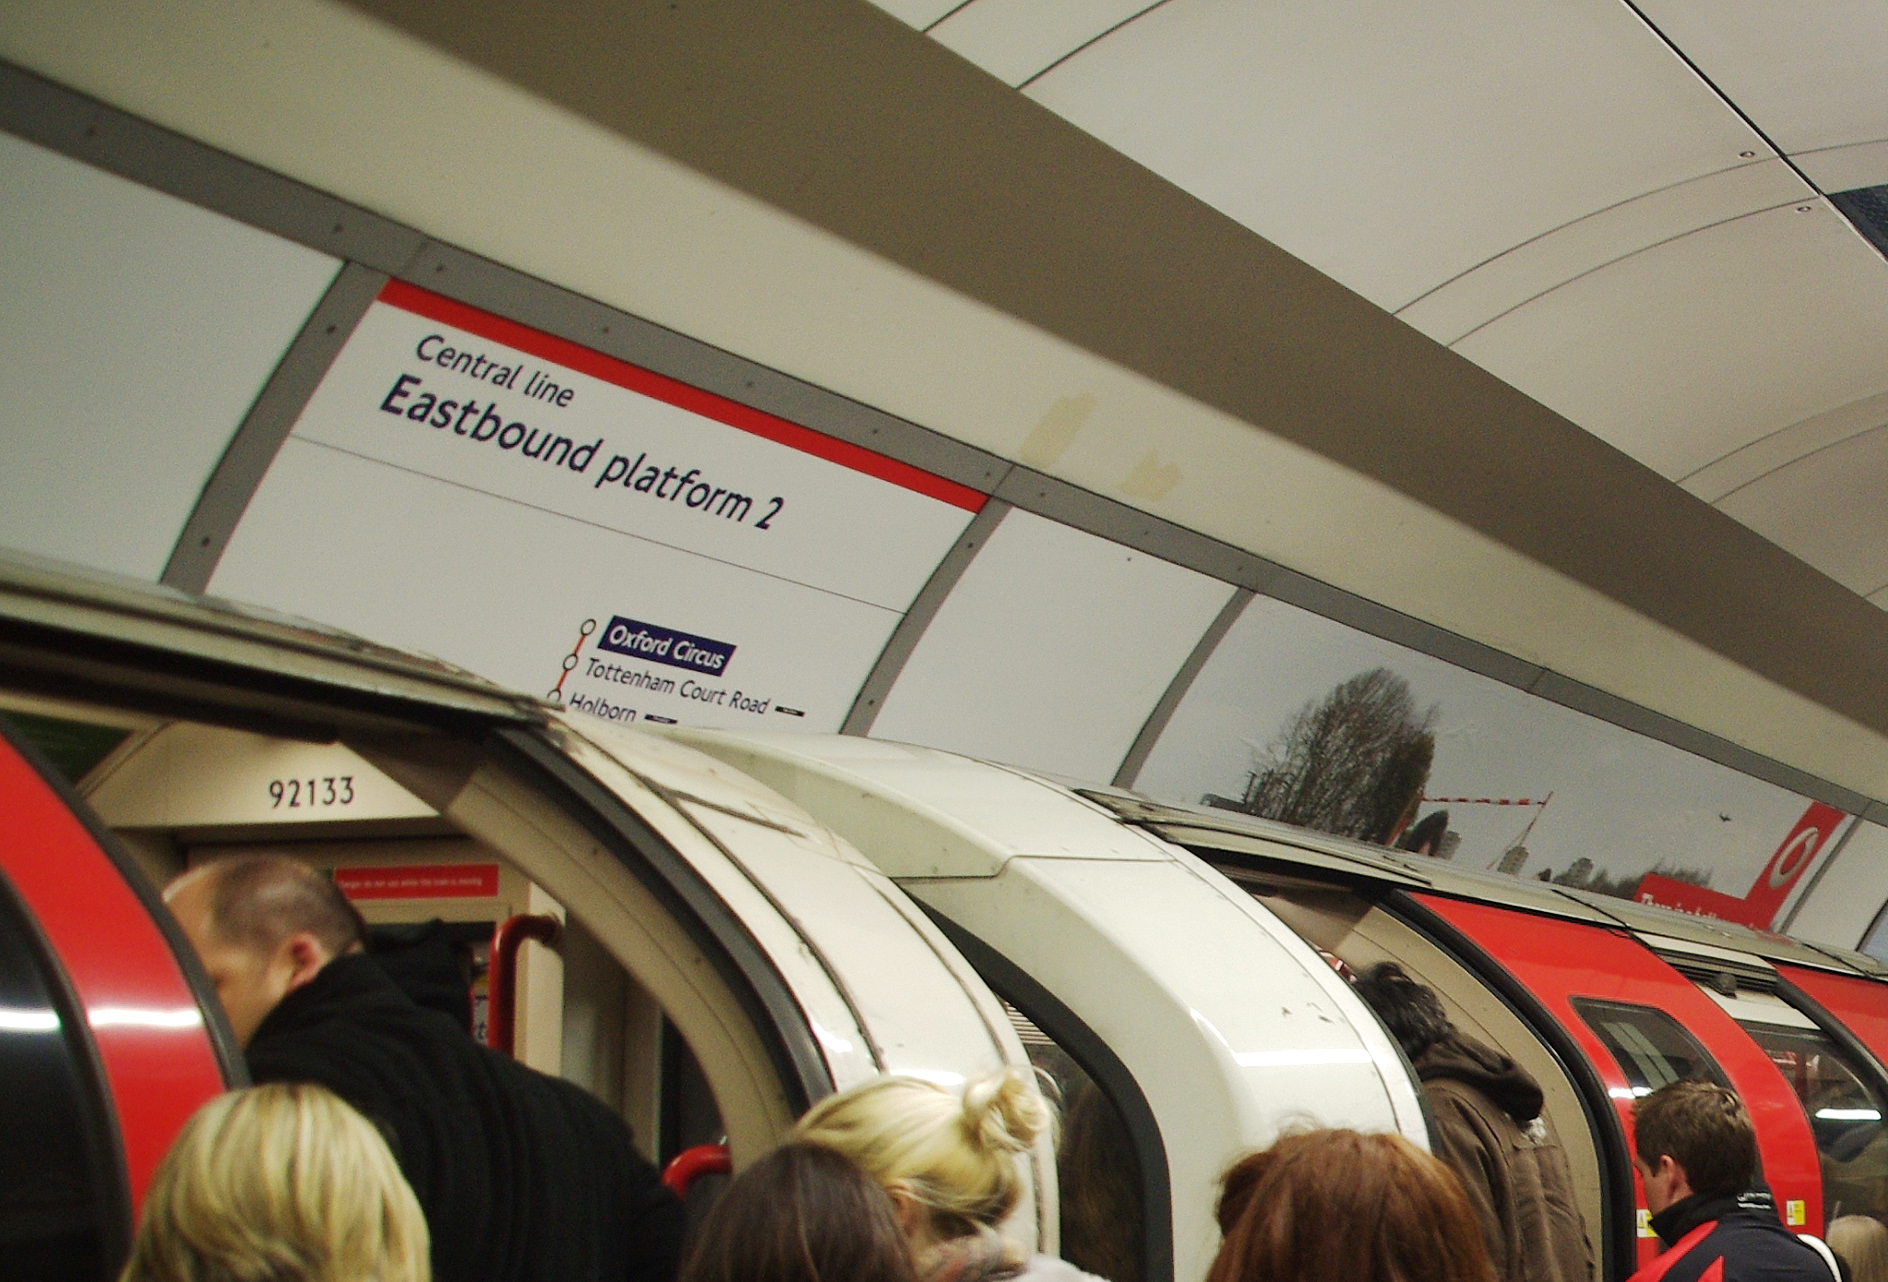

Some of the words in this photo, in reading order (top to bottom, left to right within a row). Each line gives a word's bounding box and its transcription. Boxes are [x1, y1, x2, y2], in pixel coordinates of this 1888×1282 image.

[415, 334, 524, 390] Central
[523, 370, 575, 408] line
[379, 372, 605, 474] Eastbound
[594, 452, 753, 523] platform
[753, 496, 786, 531] 2
[608, 624, 673, 657] Oxford
[672, 640, 726, 671] Circus
[568, 691, 638, 723] Holborn
[585, 657, 676, 695] Tottenham
[679, 679, 728, 706] Court
[728, 690, 771, 715] Road
[269, 776, 354, 809] 92133
